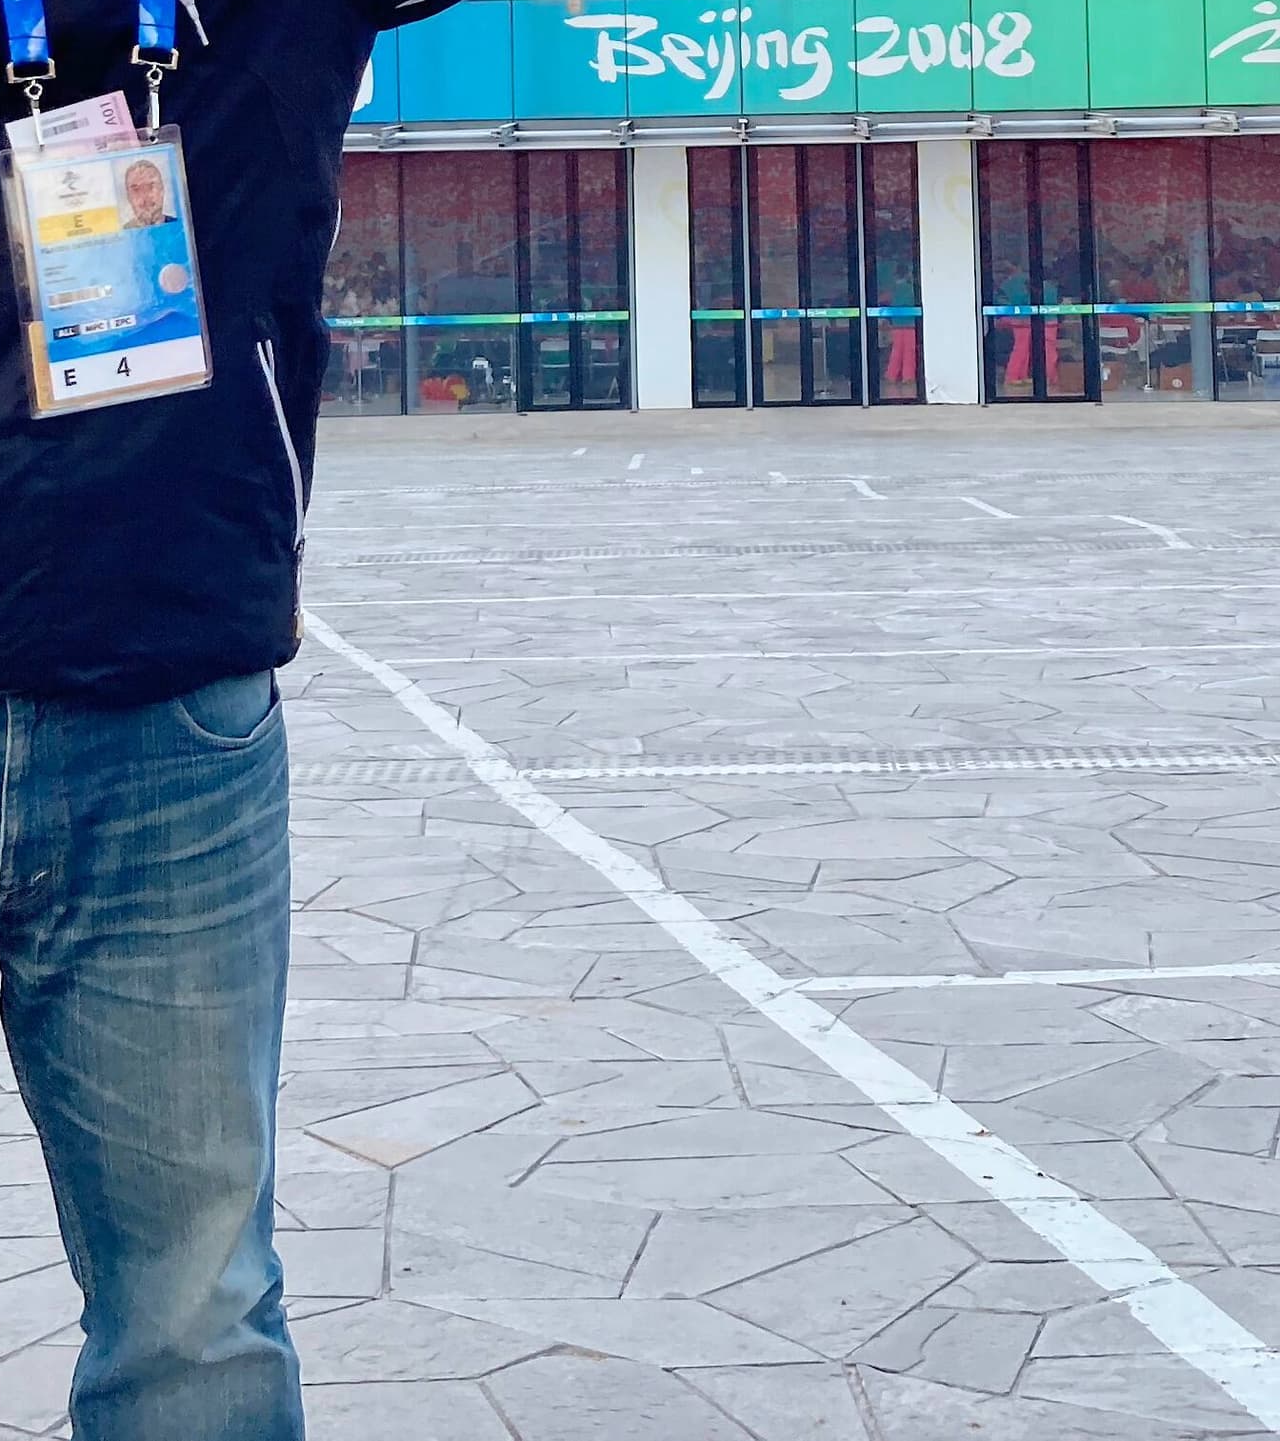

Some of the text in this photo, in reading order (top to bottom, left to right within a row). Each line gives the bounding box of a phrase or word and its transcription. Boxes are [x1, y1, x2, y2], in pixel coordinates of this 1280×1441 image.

[564, 7, 1036, 101] Beijing 2008
[73, 215, 84, 228] E
[64, 357, 131, 386] E 4
